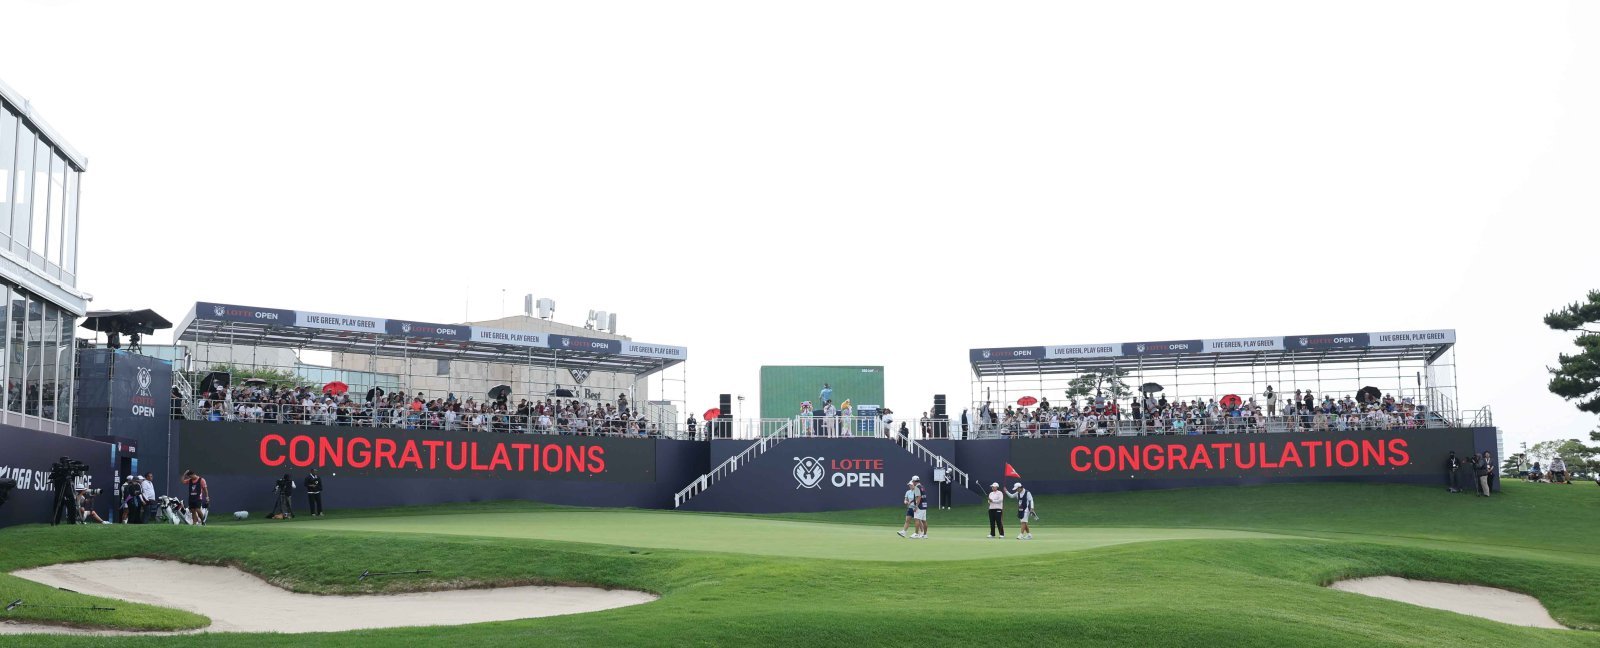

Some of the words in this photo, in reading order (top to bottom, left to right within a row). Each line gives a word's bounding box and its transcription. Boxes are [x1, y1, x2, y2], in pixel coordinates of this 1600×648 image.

[254, 312, 278, 320] OPEN
[584, 388, 601, 400] Best
[132, 404, 155, 418] OPEN
[260, 435, 604, 472] CONGRATULATIONS
[1071, 439, 1409, 471] CONGRATULATIONS
[831, 459, 884, 470] LOTTE
[831, 472, 884, 487] OPEN
